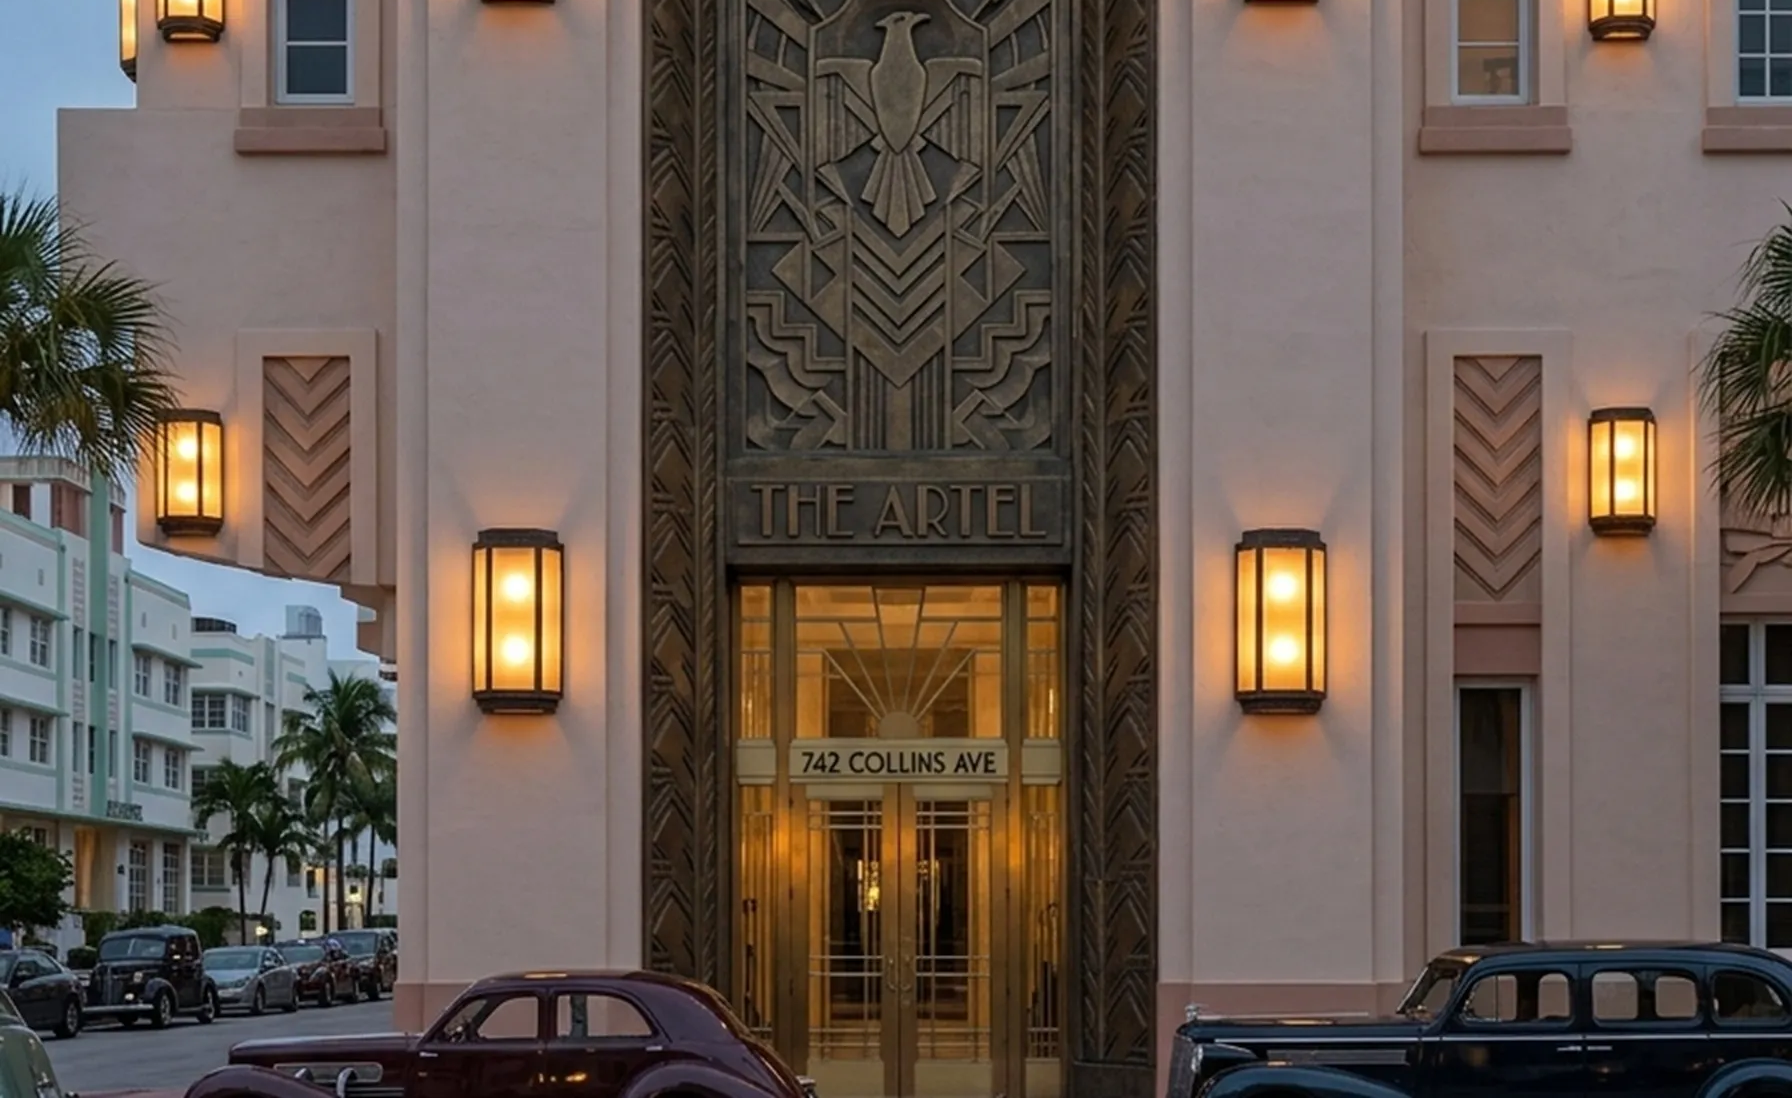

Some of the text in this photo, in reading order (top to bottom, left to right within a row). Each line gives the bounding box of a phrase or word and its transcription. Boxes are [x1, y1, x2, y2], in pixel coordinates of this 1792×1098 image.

[751, 484, 1048, 537] THE ARTEL
[801, 751, 996, 774] 742 COLLINS AVE
